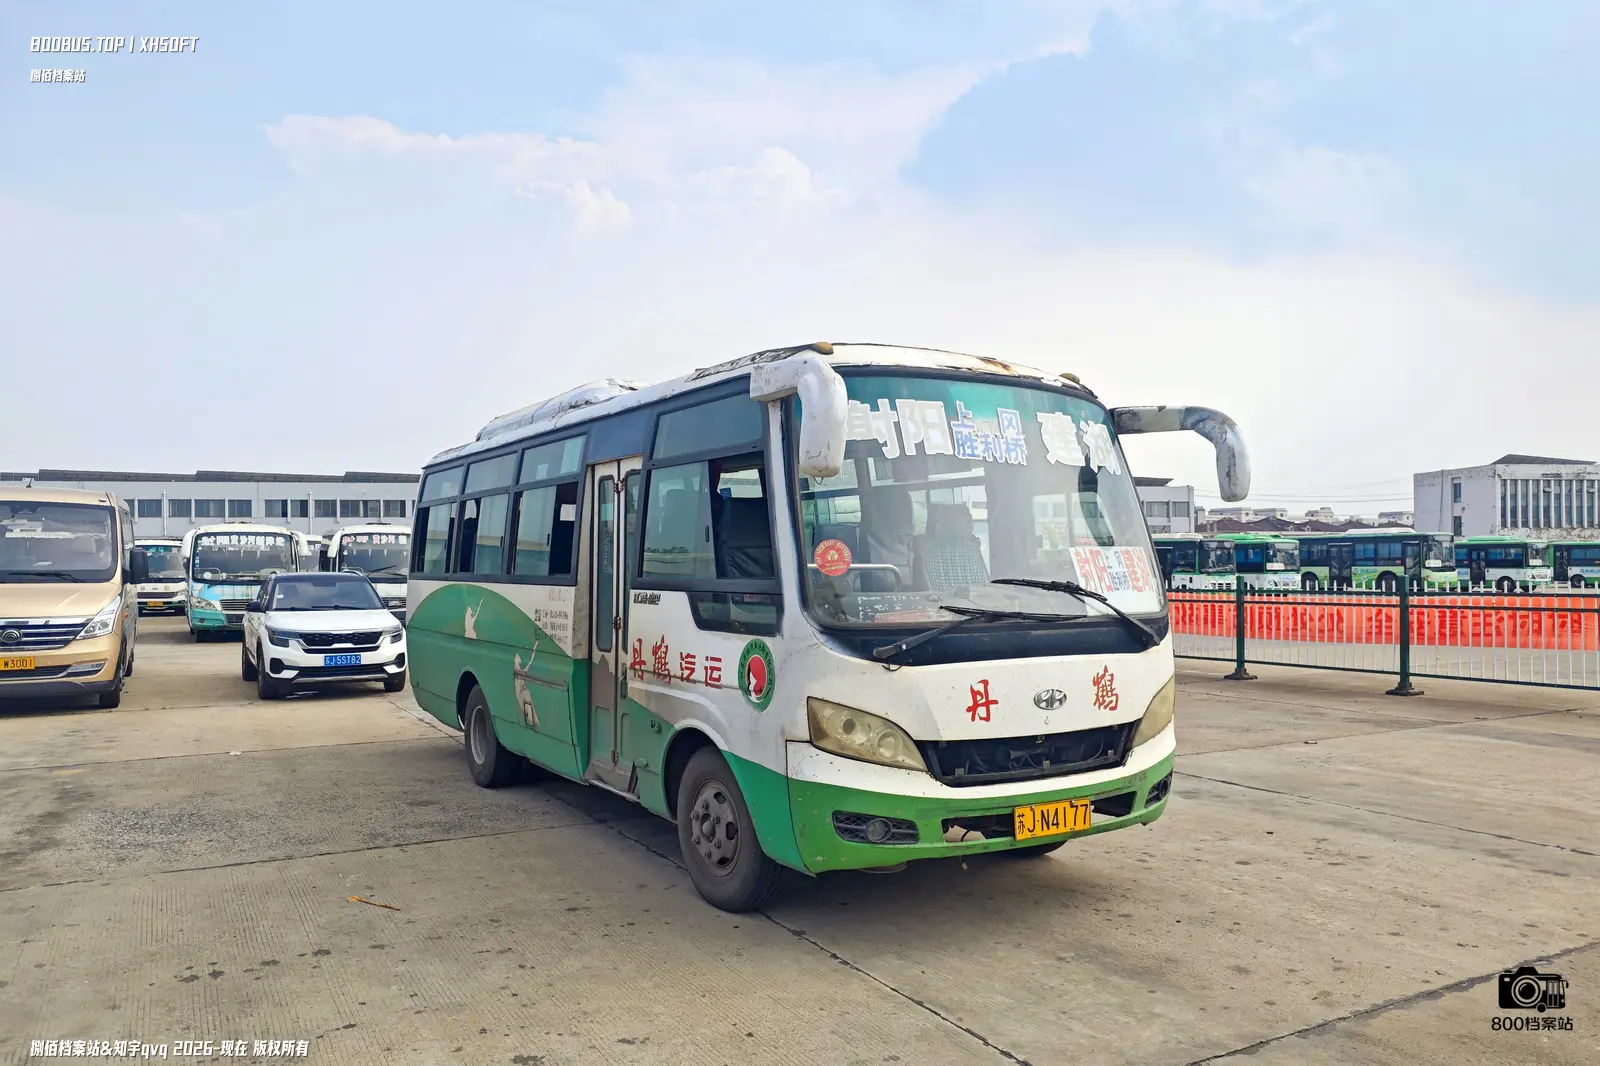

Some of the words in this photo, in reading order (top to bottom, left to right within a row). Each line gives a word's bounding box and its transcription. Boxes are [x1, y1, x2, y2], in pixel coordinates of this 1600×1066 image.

[954, 428, 1028, 466] 胜利桥
[966, 679, 999, 722] 丹
